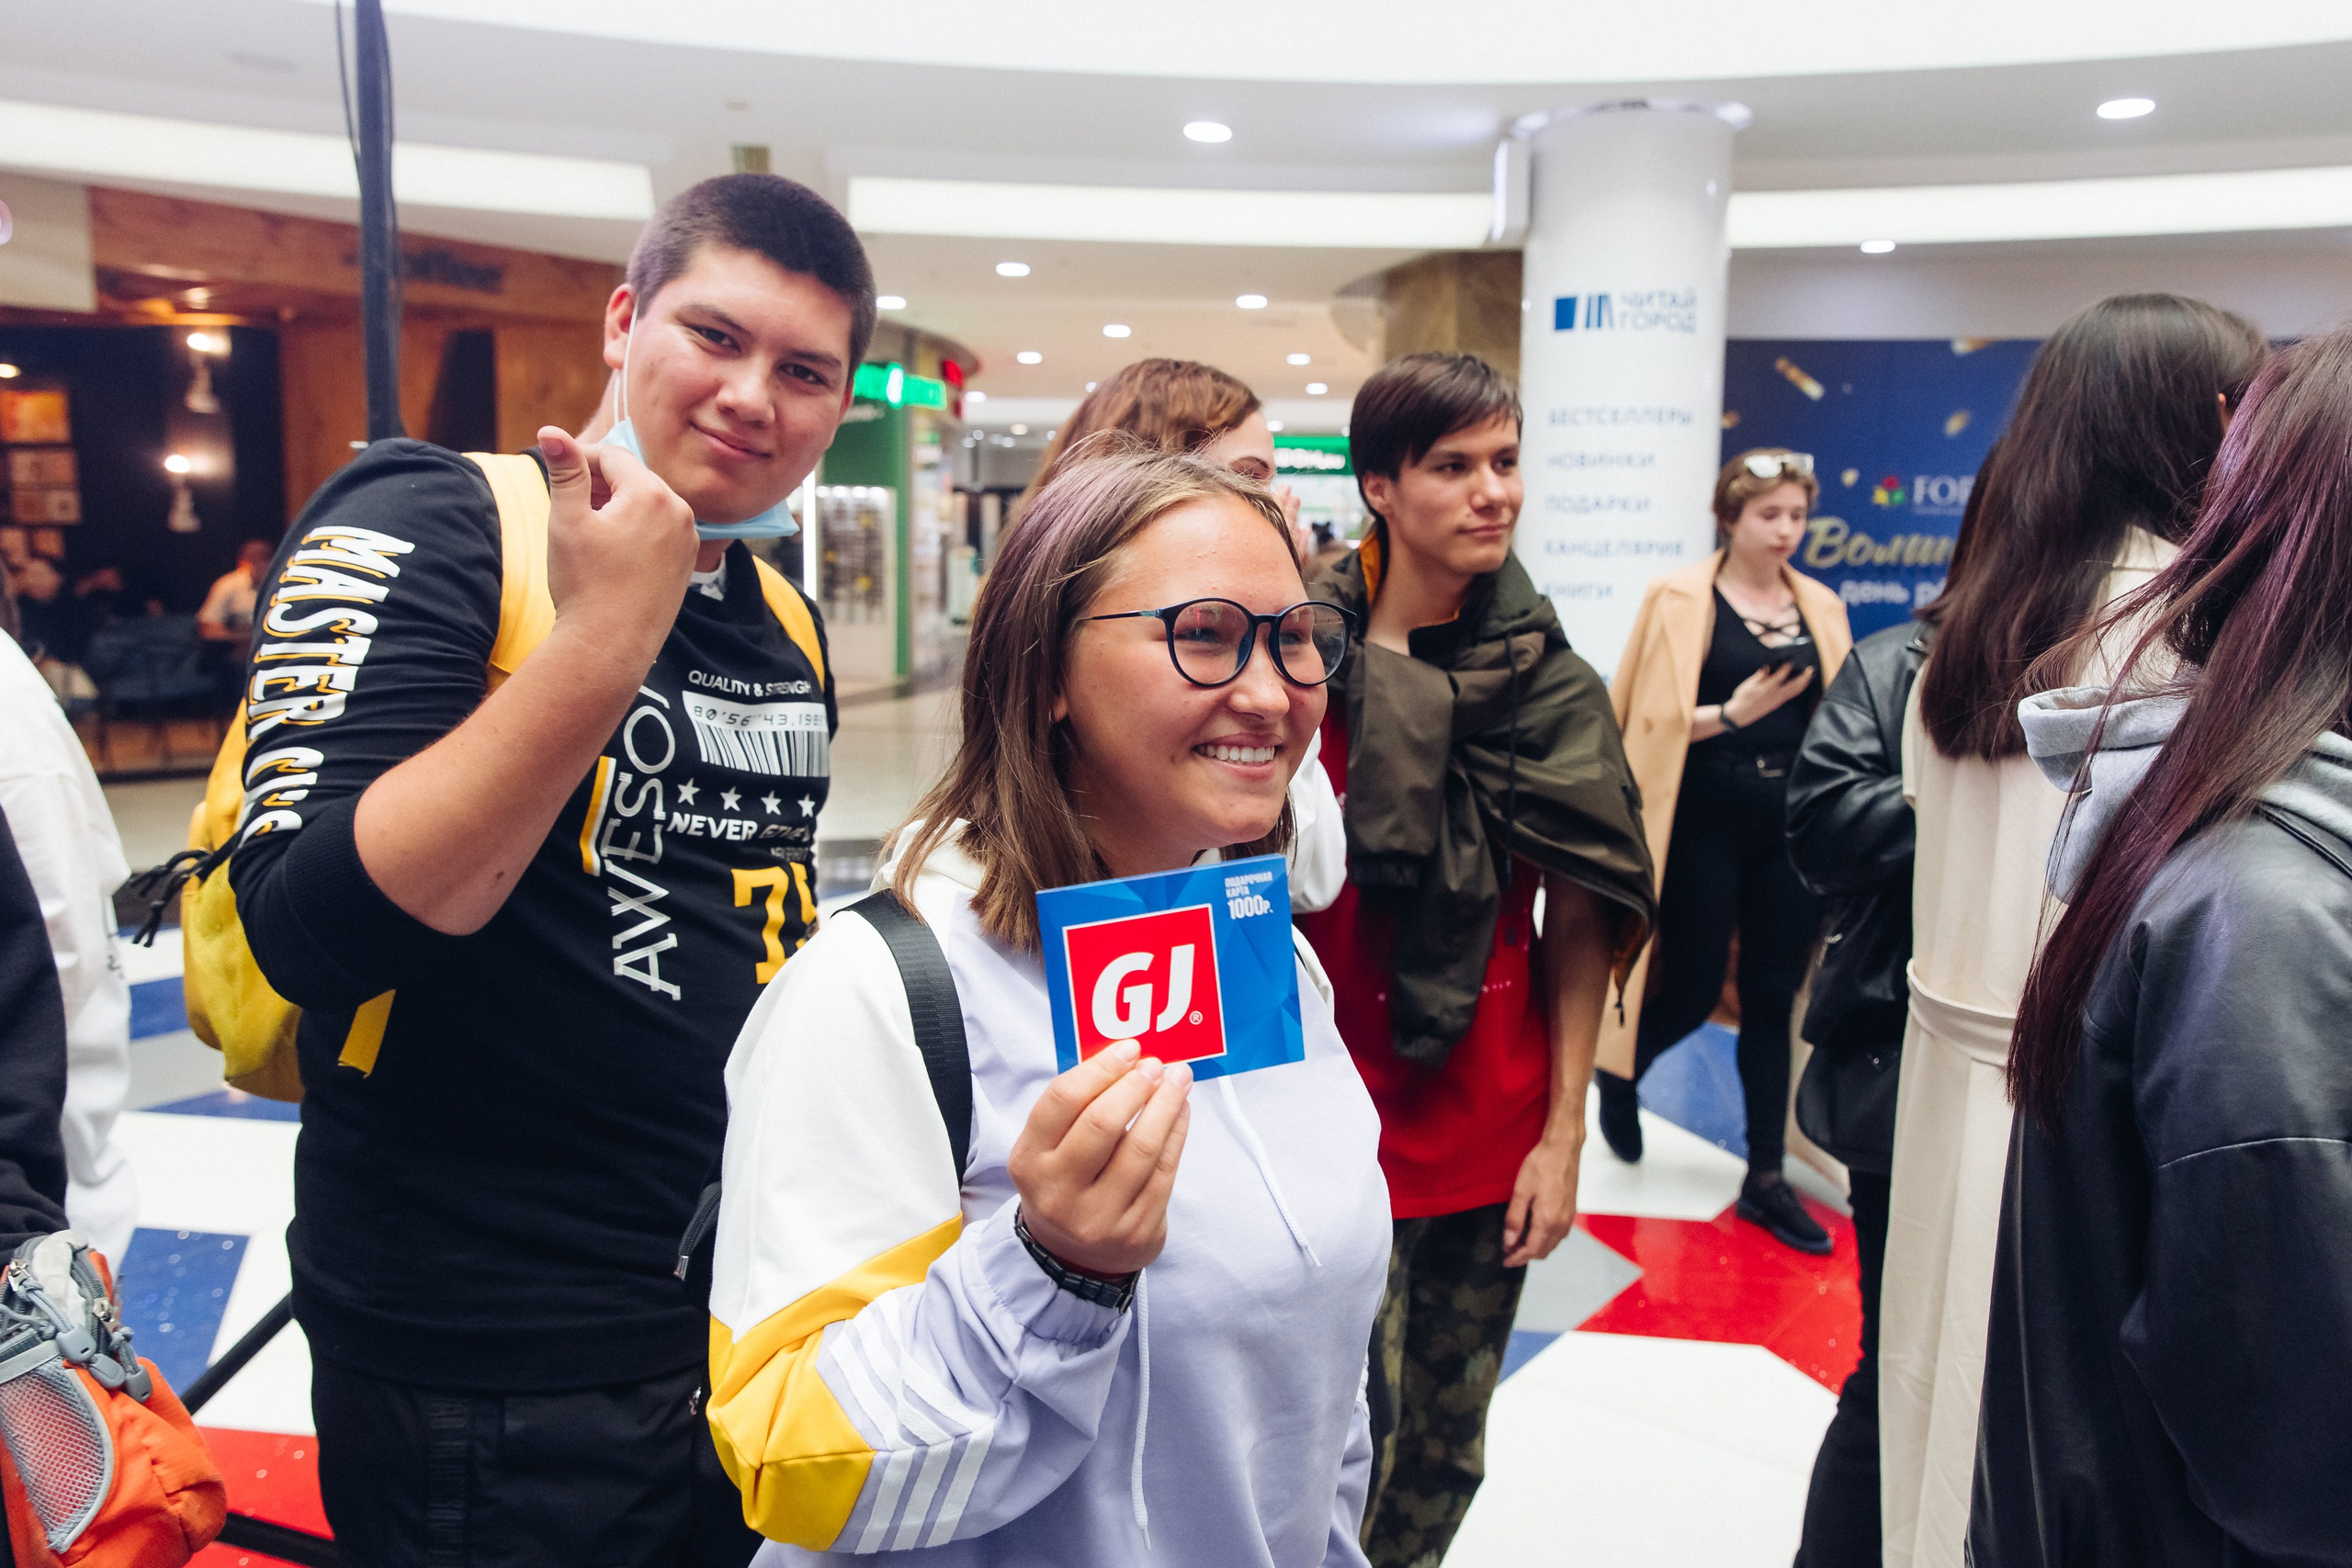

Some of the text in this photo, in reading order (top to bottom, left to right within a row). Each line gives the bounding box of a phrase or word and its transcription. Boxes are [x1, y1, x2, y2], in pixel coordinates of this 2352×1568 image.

[1619, 310, 1698, 333] ГОРОД
[1548, 406, 1695, 426] БЕСТСЕЛЛЕРЫ
[1546, 451, 1657, 469] НОВИНКИ
[1545, 494, 1652, 513] ПОДАРКИ
[247, 525, 415, 742] MASTER
[688, 670, 751, 696] QUALITY
[667, 812, 759, 841] NEVER
[600, 684, 681, 1001] AWESO
